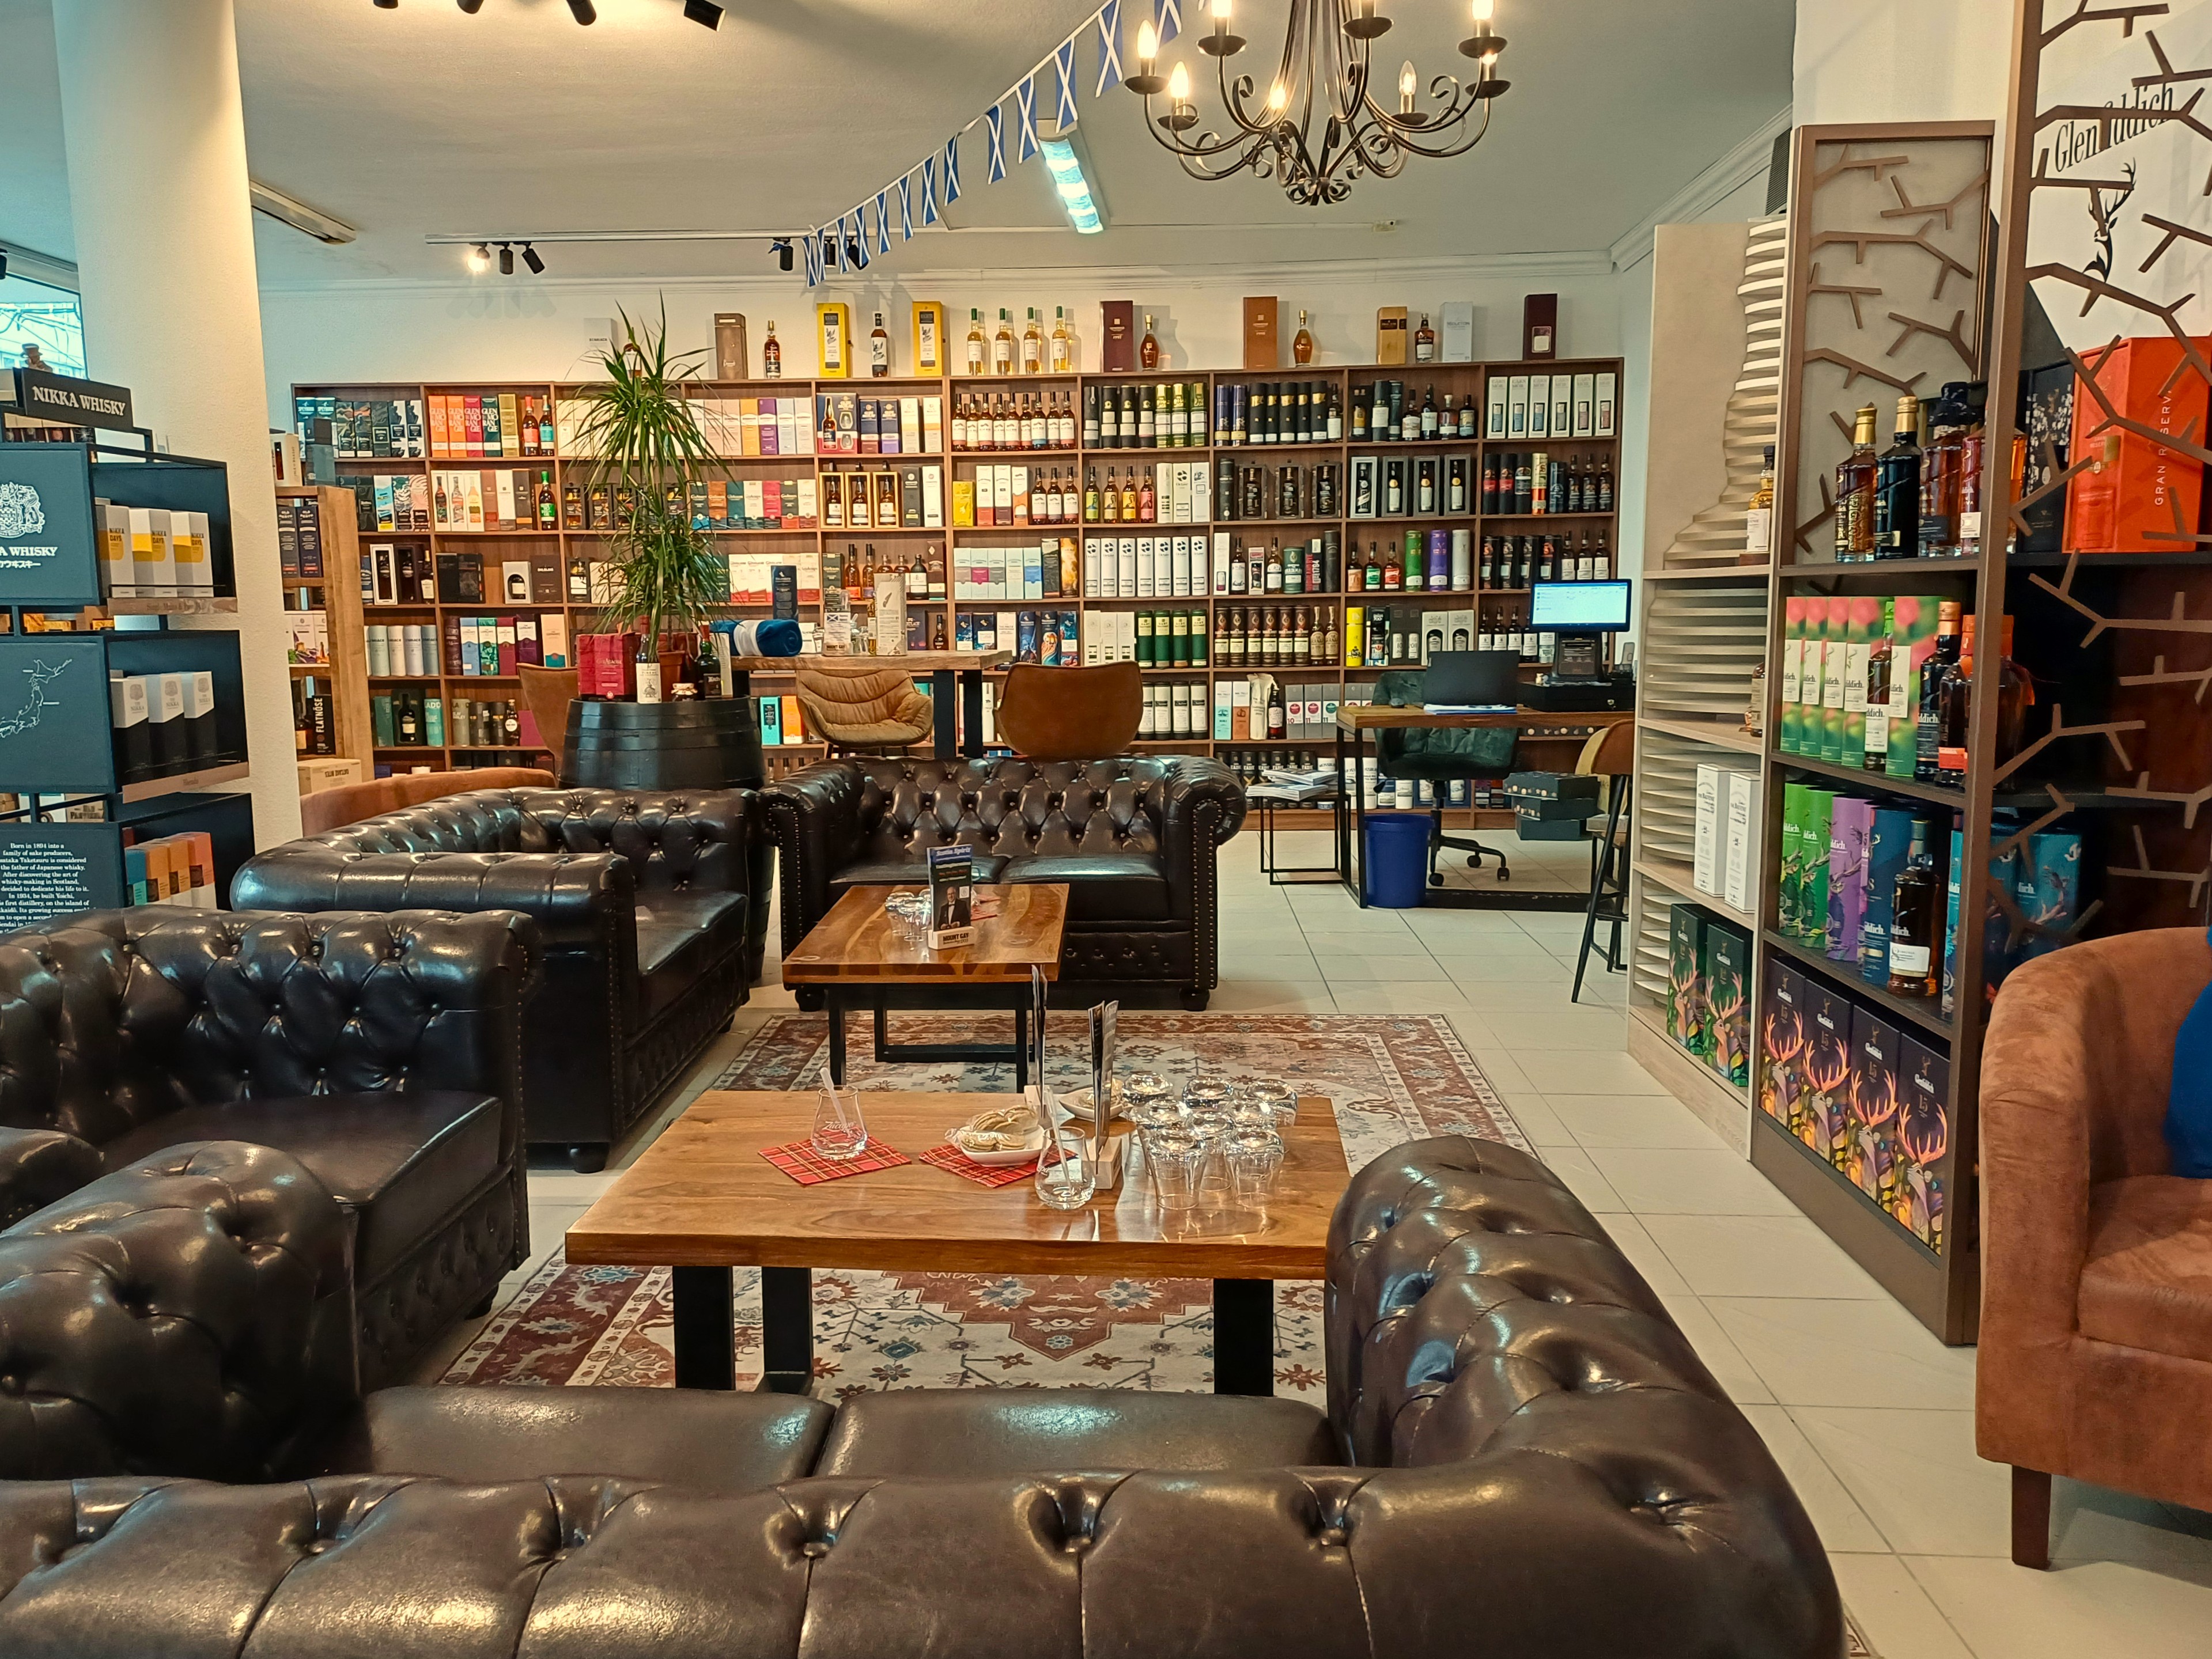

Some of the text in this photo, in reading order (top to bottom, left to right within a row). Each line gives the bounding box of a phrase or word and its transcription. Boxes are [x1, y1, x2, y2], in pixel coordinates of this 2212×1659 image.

[32, 385, 126, 416] NIKKA WHISKY
[2159, 391, 2172, 456] RSERV
[2155, 465, 2166, 506] GRAN
[9, 546, 58, 556] WHISKY
[943, 934, 959, 942] MOUNT
[1782, 1005, 1788, 1019] 15
[1821, 1031, 1829, 1047] 15
[1869, 1061, 1877, 1078] 15
[1920, 1094, 1928, 1112] 15
